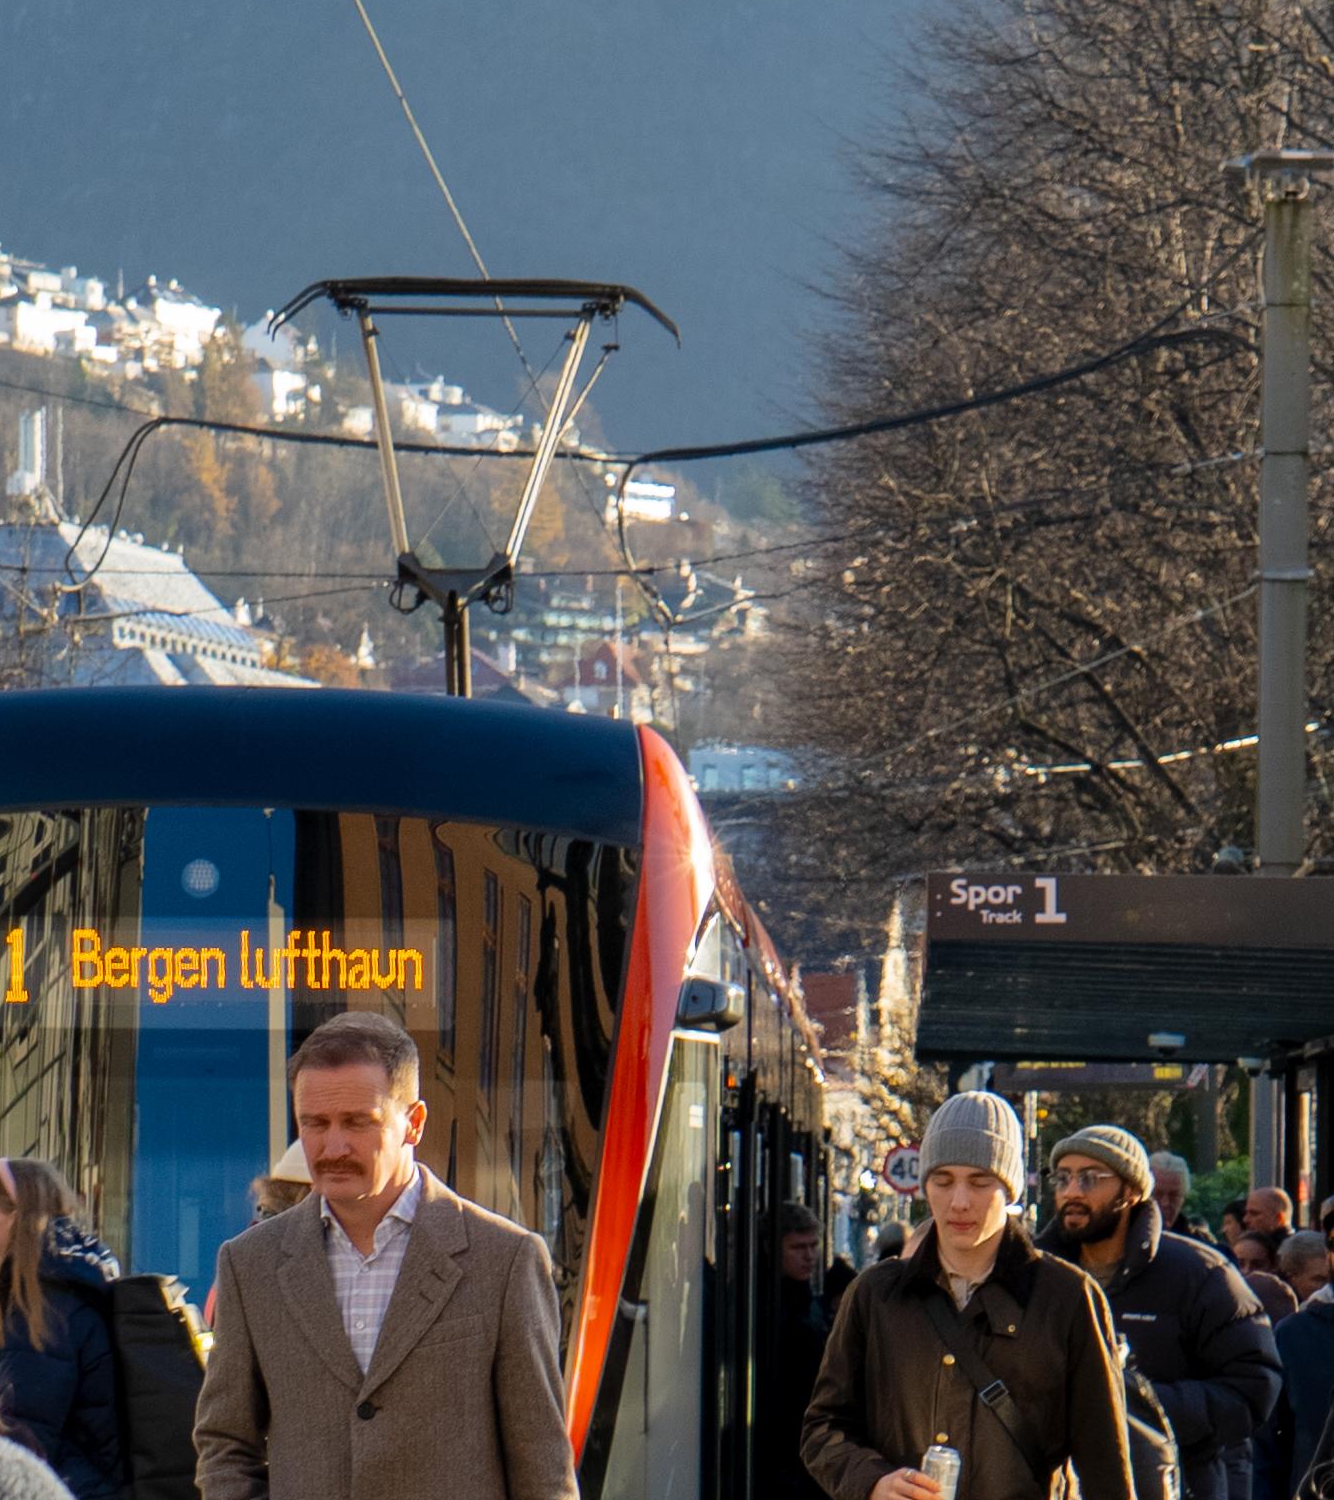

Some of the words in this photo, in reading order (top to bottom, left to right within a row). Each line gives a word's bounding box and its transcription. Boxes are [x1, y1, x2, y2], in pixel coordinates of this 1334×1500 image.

[950, 878, 1022, 911] Spor
[1034, 877, 1067, 924] 1
[980, 910, 1022, 924] Track
[5, 928, 29, 1004] 1
[71, 928, 226, 1004] Bergen
[240, 929, 424, 990] lufthavn
